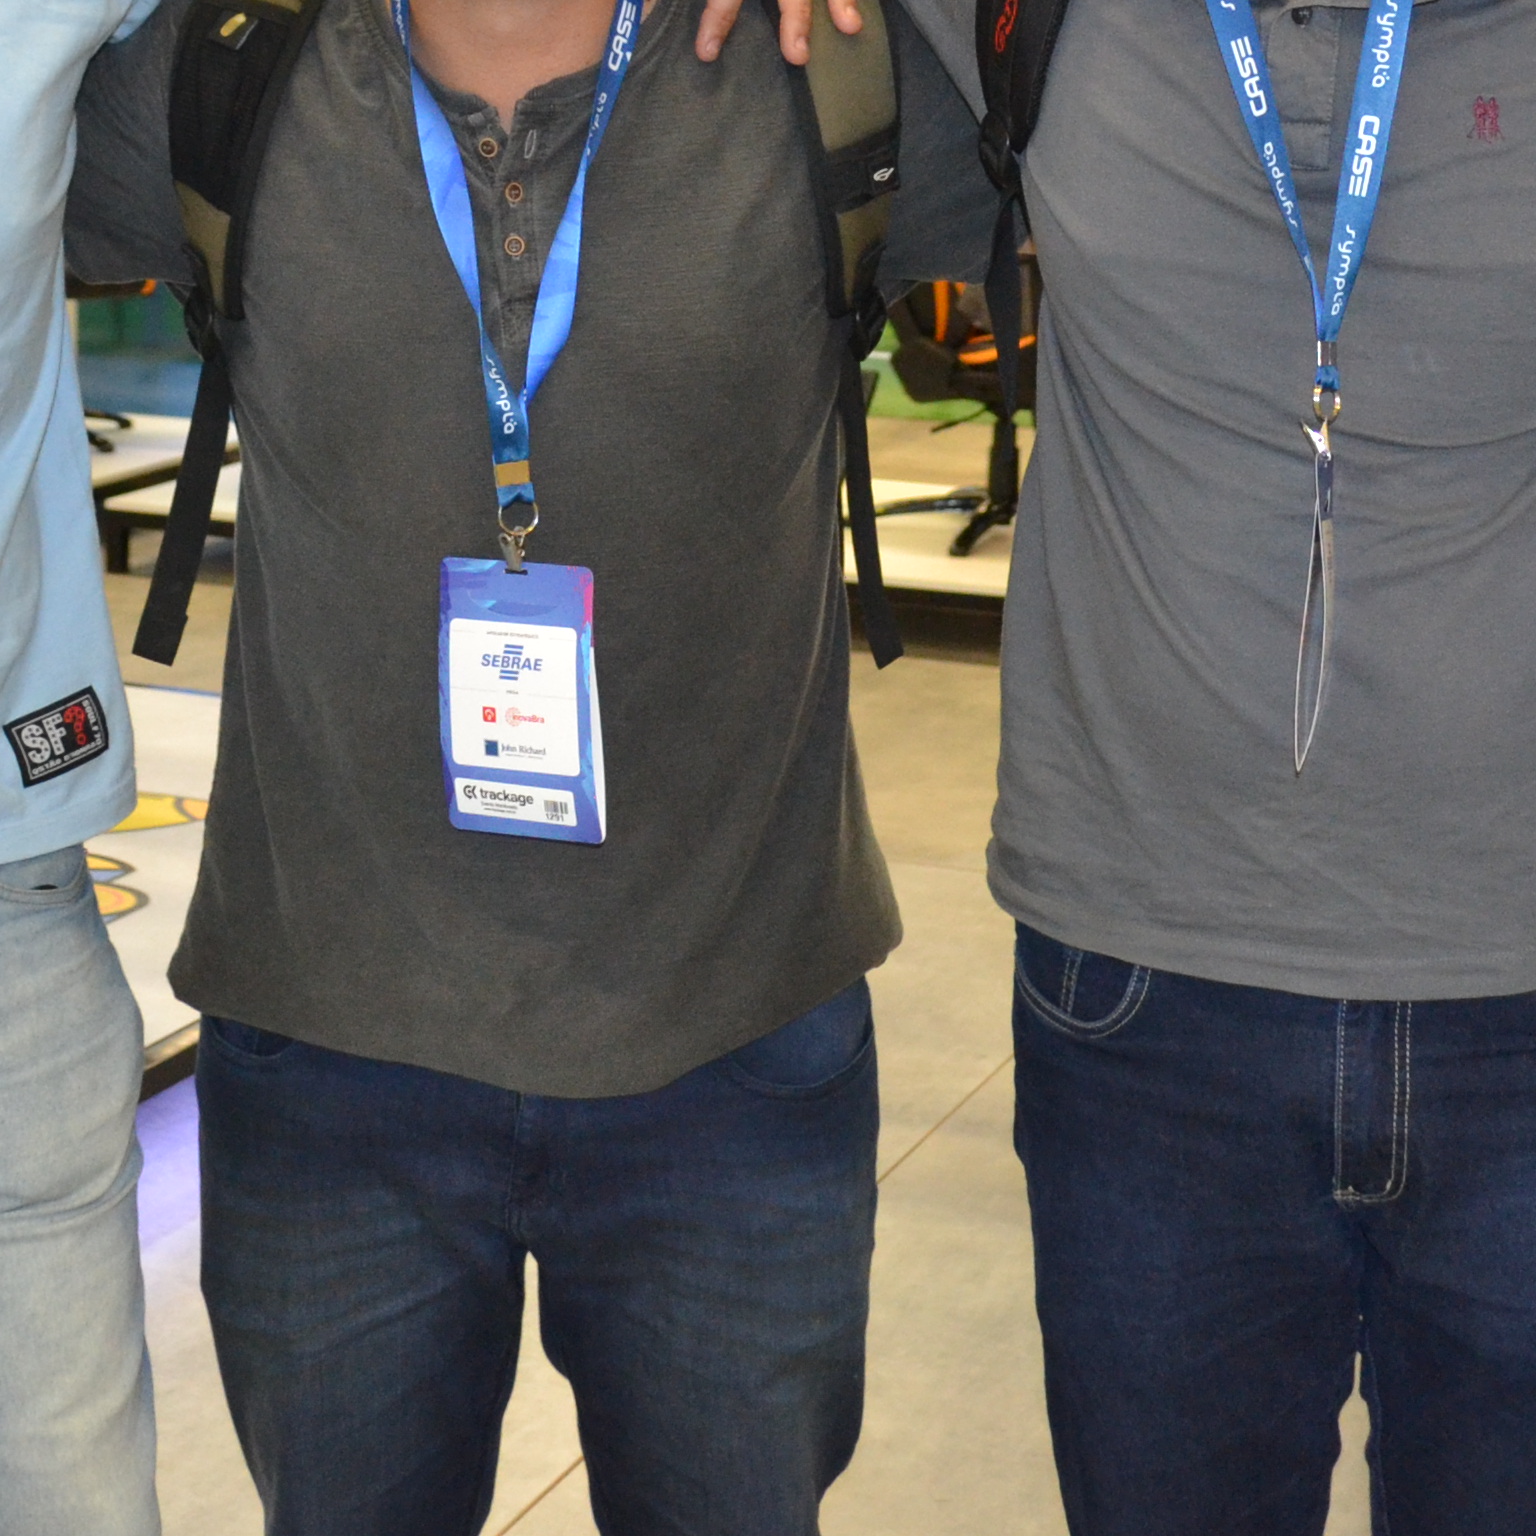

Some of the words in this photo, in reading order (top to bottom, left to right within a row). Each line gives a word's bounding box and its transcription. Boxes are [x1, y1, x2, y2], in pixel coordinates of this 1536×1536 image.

[607, 0, 637, 72] CASE
[1230, 35, 1268, 118] CASE
[1348, 114, 1381, 198] CASE
[481, 653, 543, 672] SEBRAE
[480, 788, 534, 807] trackage
